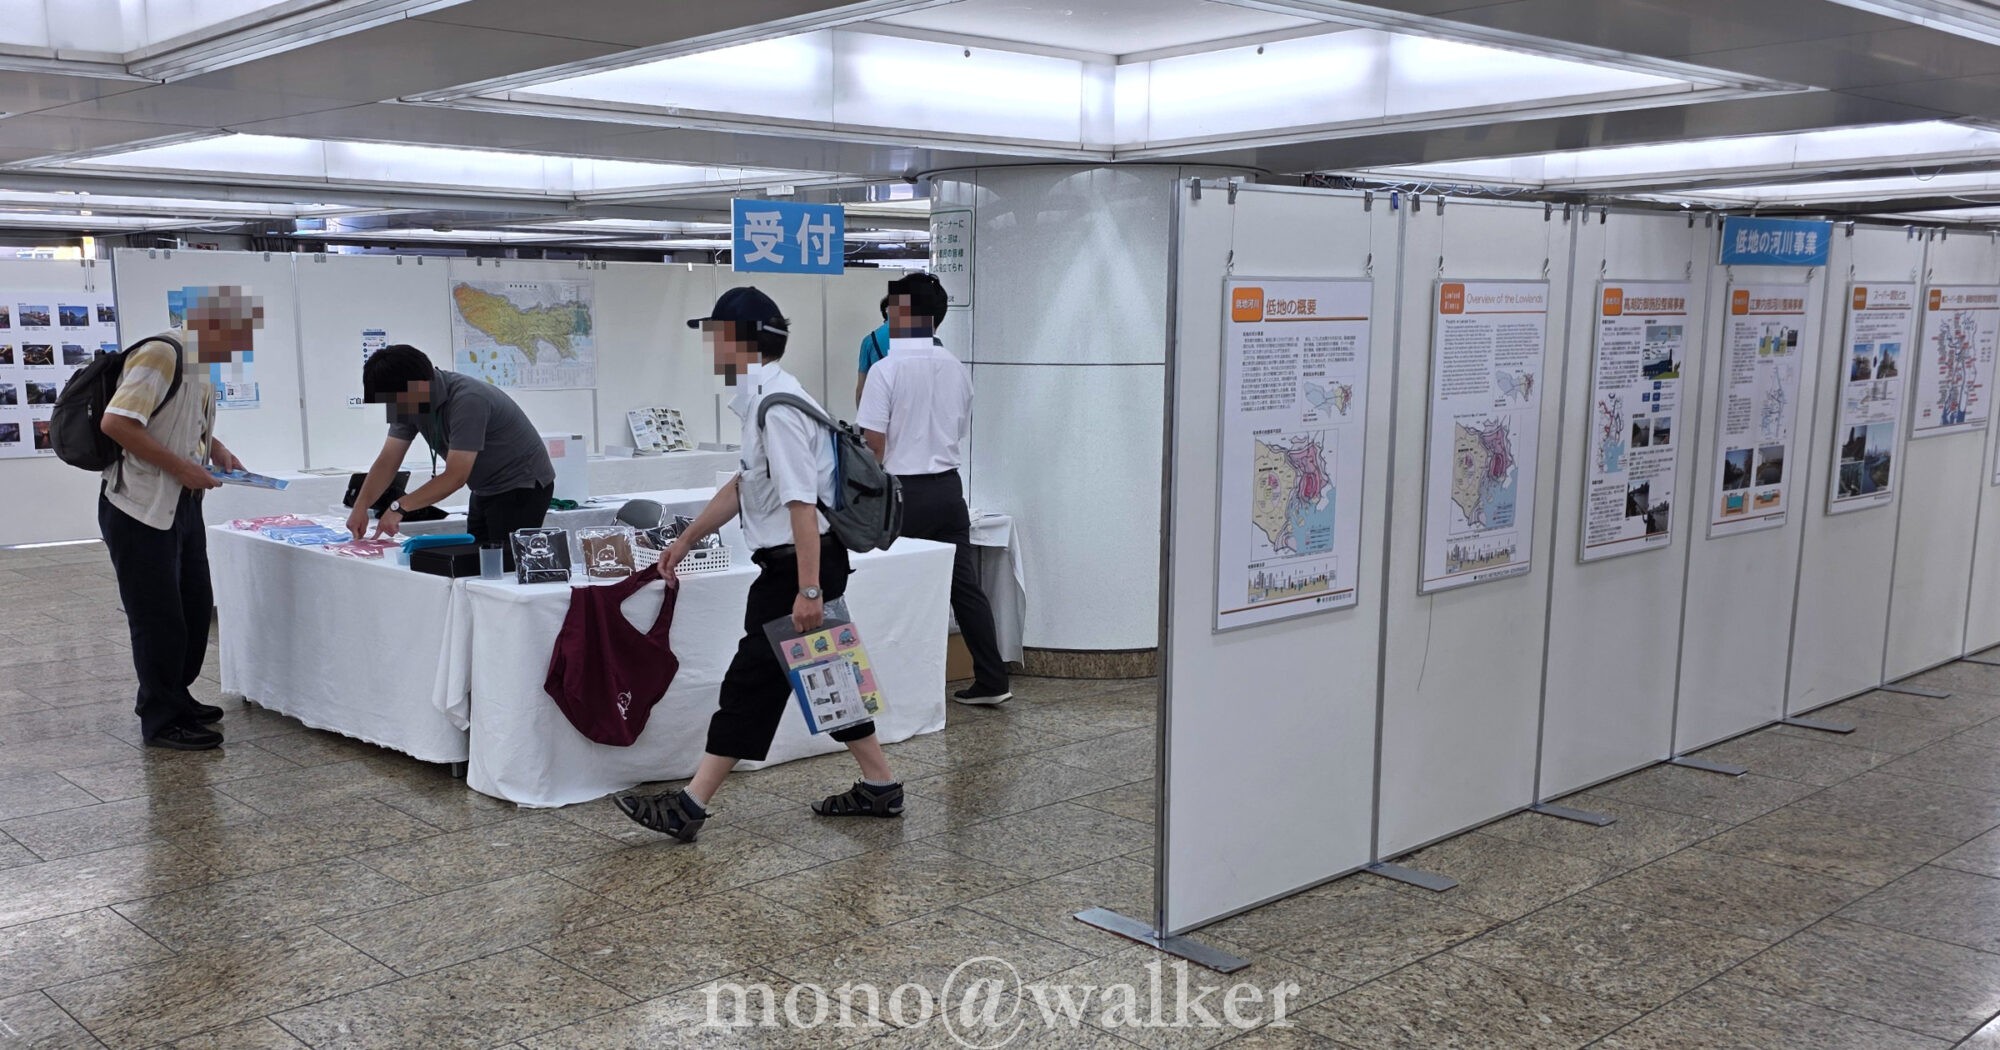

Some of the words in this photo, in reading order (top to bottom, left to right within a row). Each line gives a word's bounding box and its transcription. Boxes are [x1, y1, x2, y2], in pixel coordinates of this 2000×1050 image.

[744, 210, 836, 265] 受付
[1735, 228, 1818, 256] 低地の河川事業
[1266, 298, 1317, 316] 低地の概要
[1466, 293, 1495, 304] Overview
[1496, 292, 1504, 304] of
[1504, 293, 1515, 304] the
[1515, 292, 1543, 304] Lowlands
[349, 397, 365, 405] ご自
